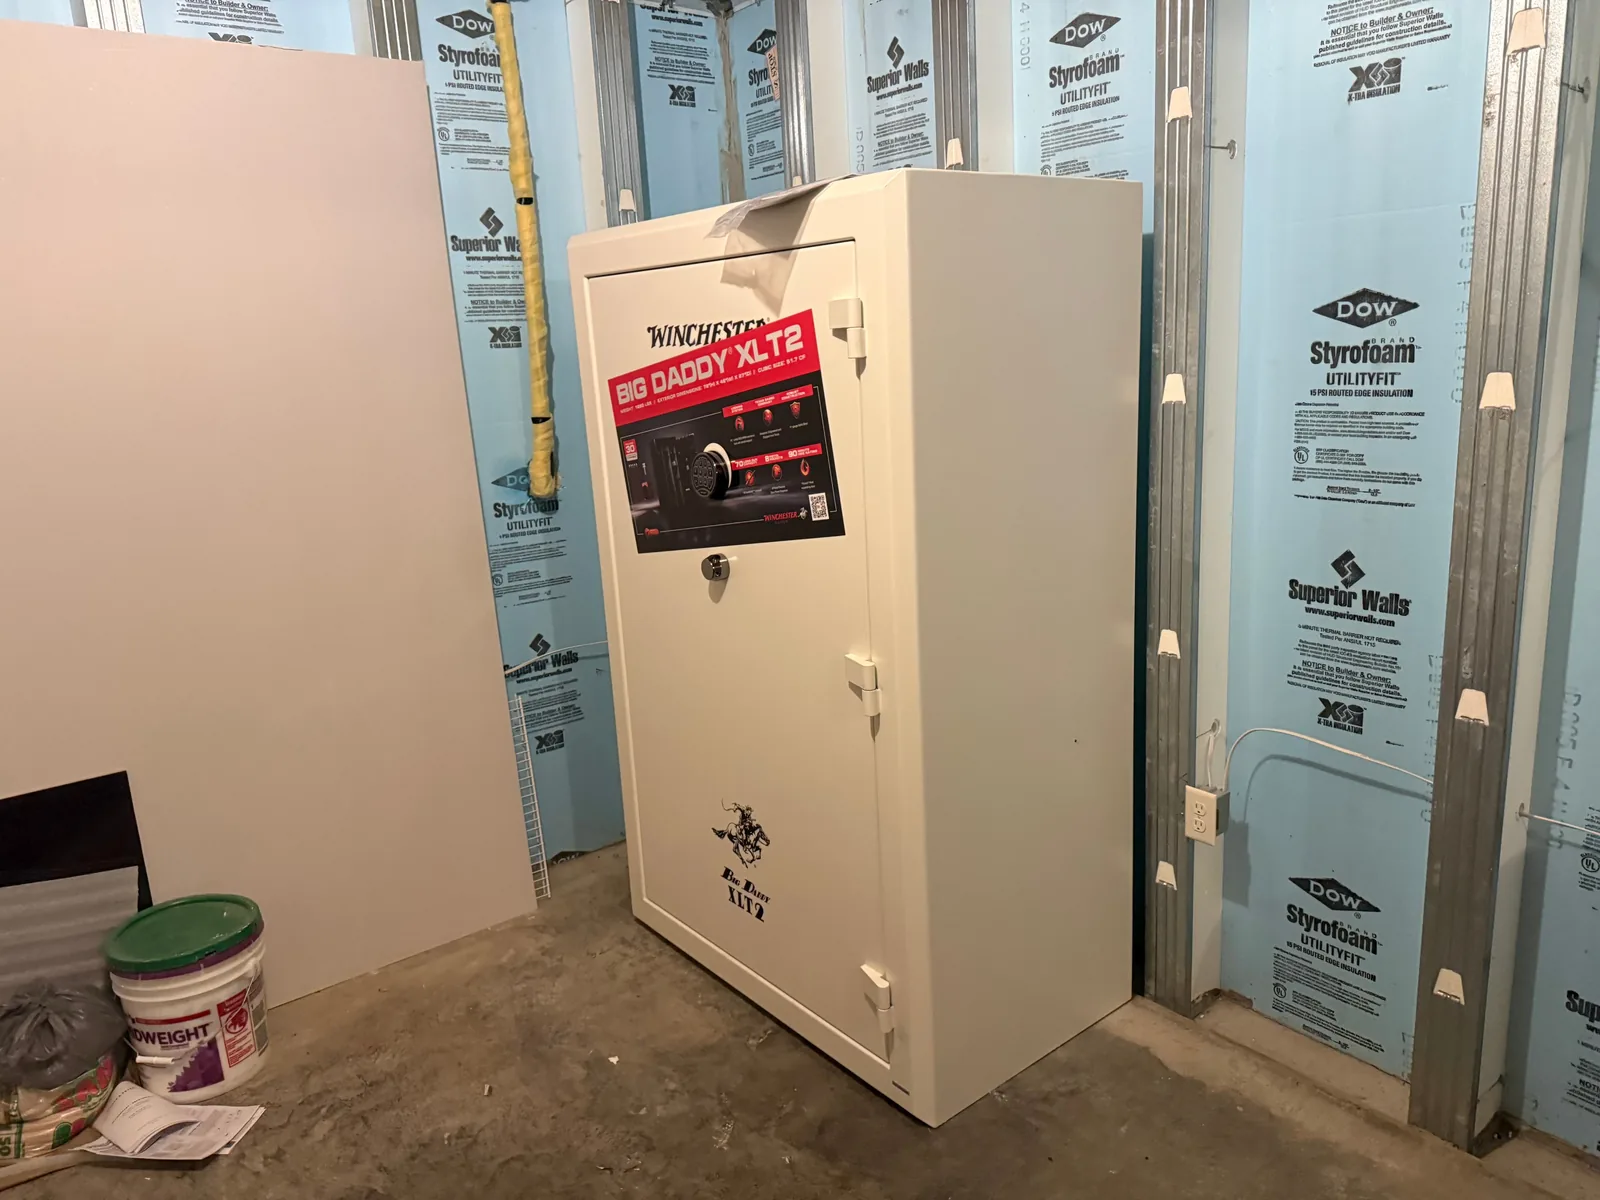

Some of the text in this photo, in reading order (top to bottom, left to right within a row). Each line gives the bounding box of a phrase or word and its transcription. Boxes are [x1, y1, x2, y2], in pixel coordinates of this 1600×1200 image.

[452, 15, 494, 32] DOW
[1065, 18, 1106, 42] DOW
[1331, 23, 1359, 36] NOTICE
[1370, 16, 1396, 27] Builder
[1406, 7, 1434, 18] Owner:
[1332, 33, 1356, 42] essential
[1400, 18, 1424, 27] Superior
[1426, 12, 1443, 20] Walls
[1319, 42, 1345, 54] published
[1346, 36, 1374, 48] guidelines
[1385, 26, 1422, 38] construction
[1424, 20, 1446, 28] details.
[438, 44, 500, 67] Styrofoa
[453, 69, 502, 83] UTILITYFIT
[748, 68, 768, 86] Styro
[867, 60, 929, 93] Superior Walls
[1049, 54, 1120, 90] Styrofoam
[1060, 82, 1108, 105] UTILITYFIT
[1366, 84, 1400, 98] INSULATION
[450, 235, 501, 254] Superior
[1336, 301, 1398, 318] DOW
[616, 379, 647, 405] BIG
[651, 348, 728, 394] DADDY
[734, 324, 804, 368] XLT2
[1310, 340, 1414, 368] Styrofoam
[1326, 372, 1396, 386] UTILITYFIT
[1372, 390, 1413, 398] INSULATION
[507, 517, 553, 530] UTILITYFIT
[1288, 579, 1410, 616] Superior Walls
[1304, 606, 1395, 627] www.superiorwalls.com
[551, 650, 579, 668] Walls
[1302, 660, 1326, 670] NOTICE
[1336, 666, 1358, 676] Builder
[1366, 673, 1391, 684] Owner:
[728, 884, 764, 923] XLT2
[1308, 880, 1360, 910] DOW
[1286, 904, 1378, 956] Styrofoam
[1301, 934, 1361, 966] UTILITYFIT
[1293, 943, 1302, 952] PSI
[1303, 946, 1324, 961] ROUTED
[1326, 954, 1340, 968] EDGE
[1340, 962, 1376, 982] INSULATION
